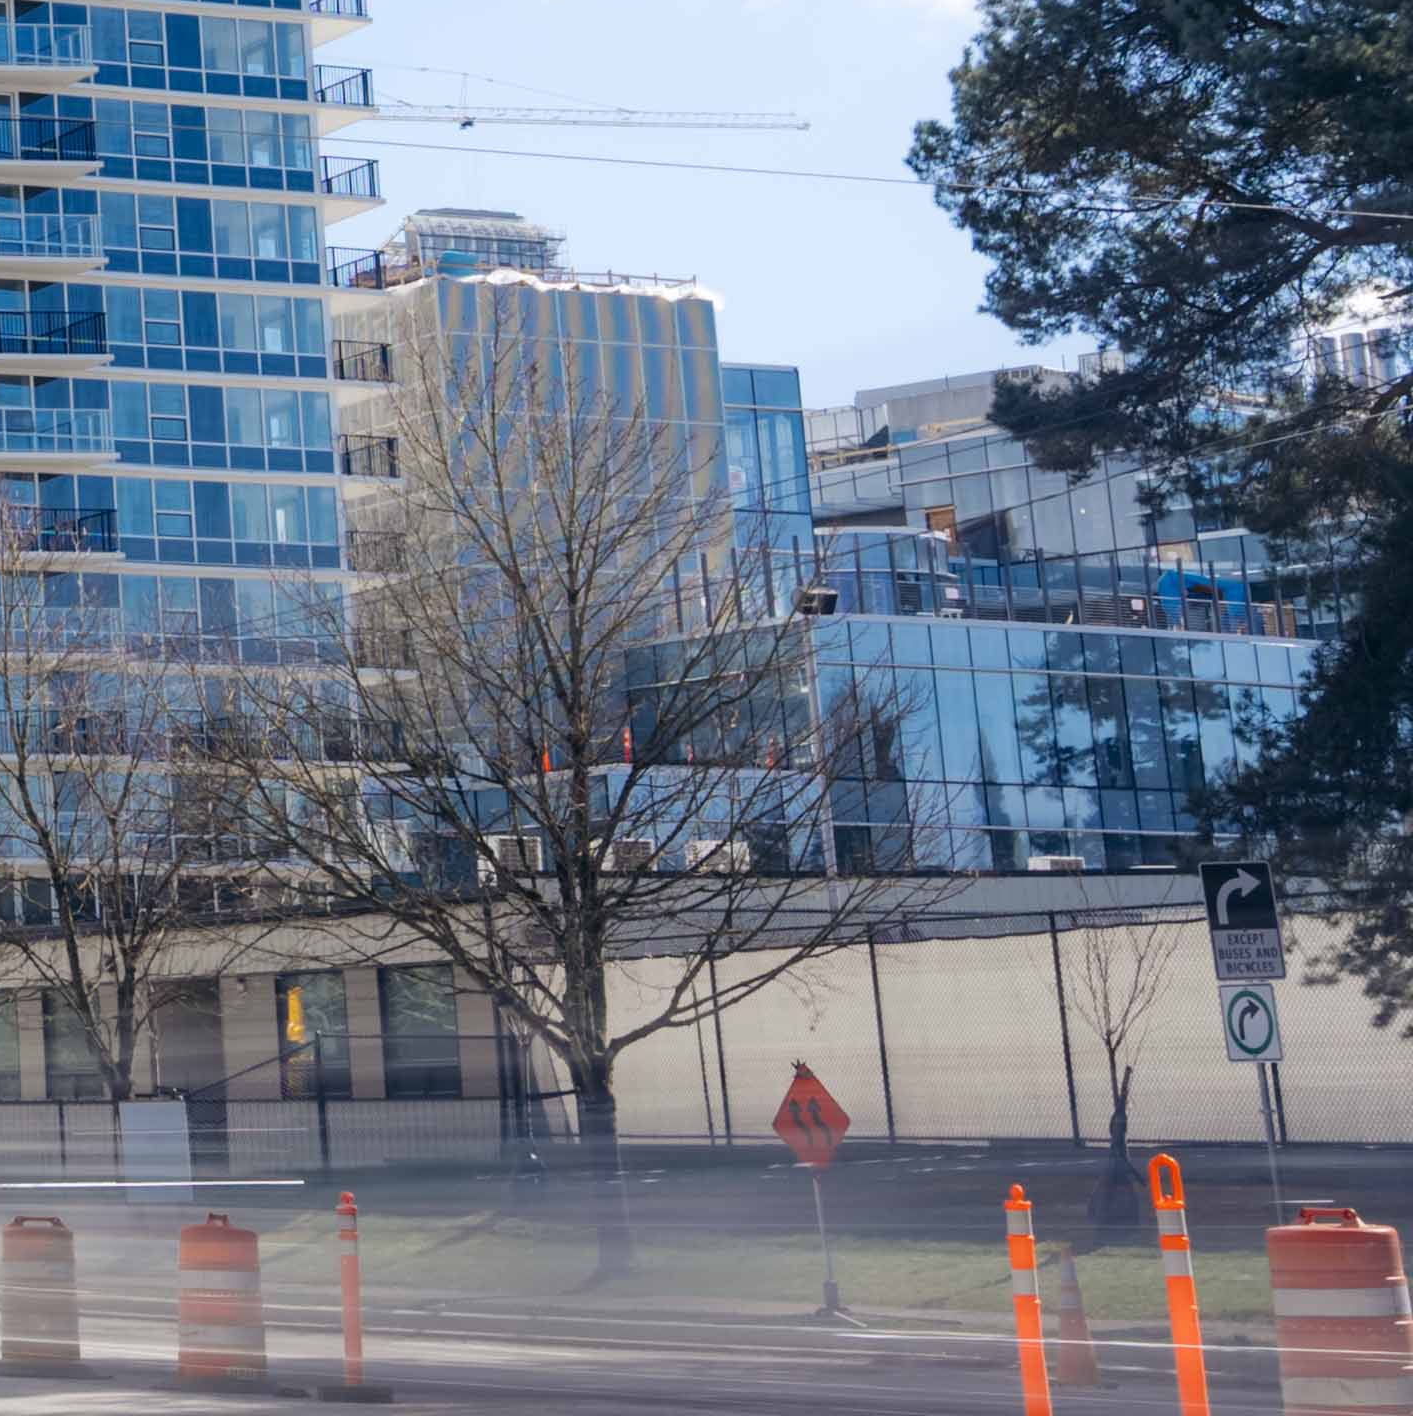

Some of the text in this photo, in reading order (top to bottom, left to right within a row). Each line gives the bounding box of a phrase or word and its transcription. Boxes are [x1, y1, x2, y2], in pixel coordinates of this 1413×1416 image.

[1227, 933, 1265, 945] EXCEPT
[1218, 947, 1278, 960] BUSES AND
[1226, 961, 1276, 973] BICYCLES
